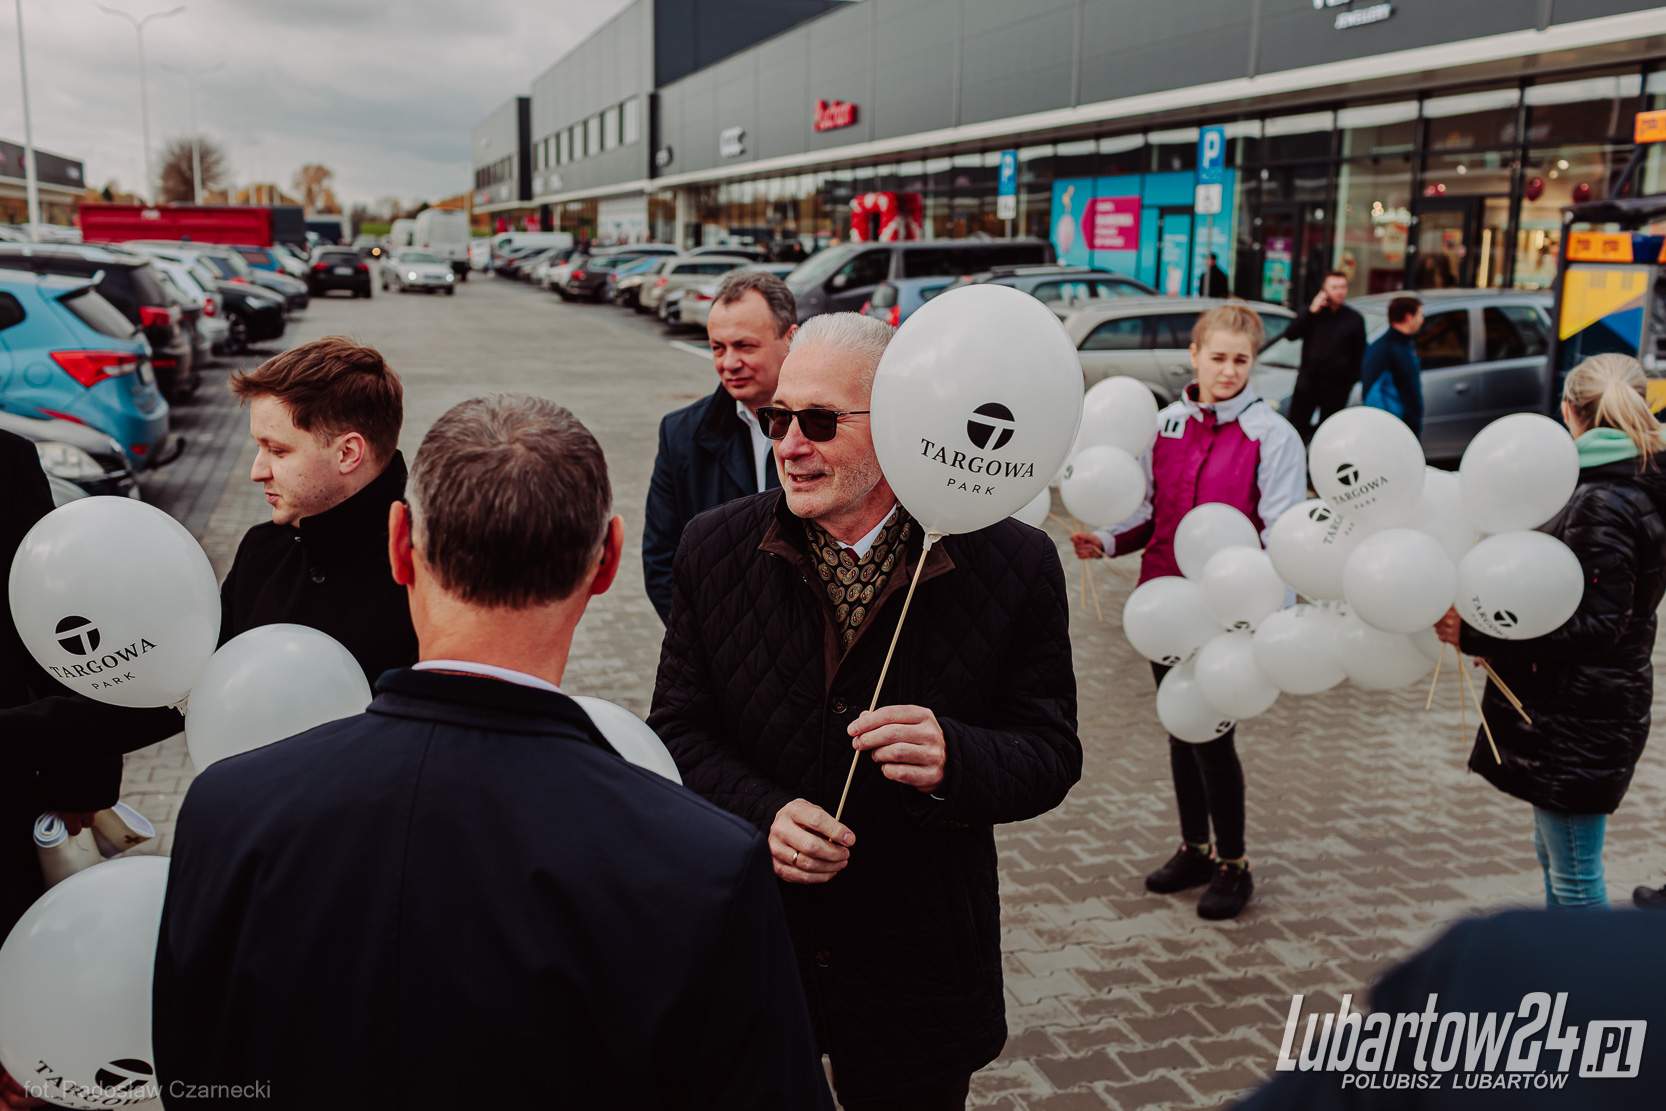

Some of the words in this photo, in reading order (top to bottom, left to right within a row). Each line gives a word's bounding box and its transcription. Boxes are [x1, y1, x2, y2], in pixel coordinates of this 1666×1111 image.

[921, 438, 1035, 478] TARGOWA
[946, 478, 996, 496] PARK
[1332, 475, 1389, 505] TARGOWA
[50, 637, 158, 679] TARGOWA
[91, 671, 136, 690] PARK
